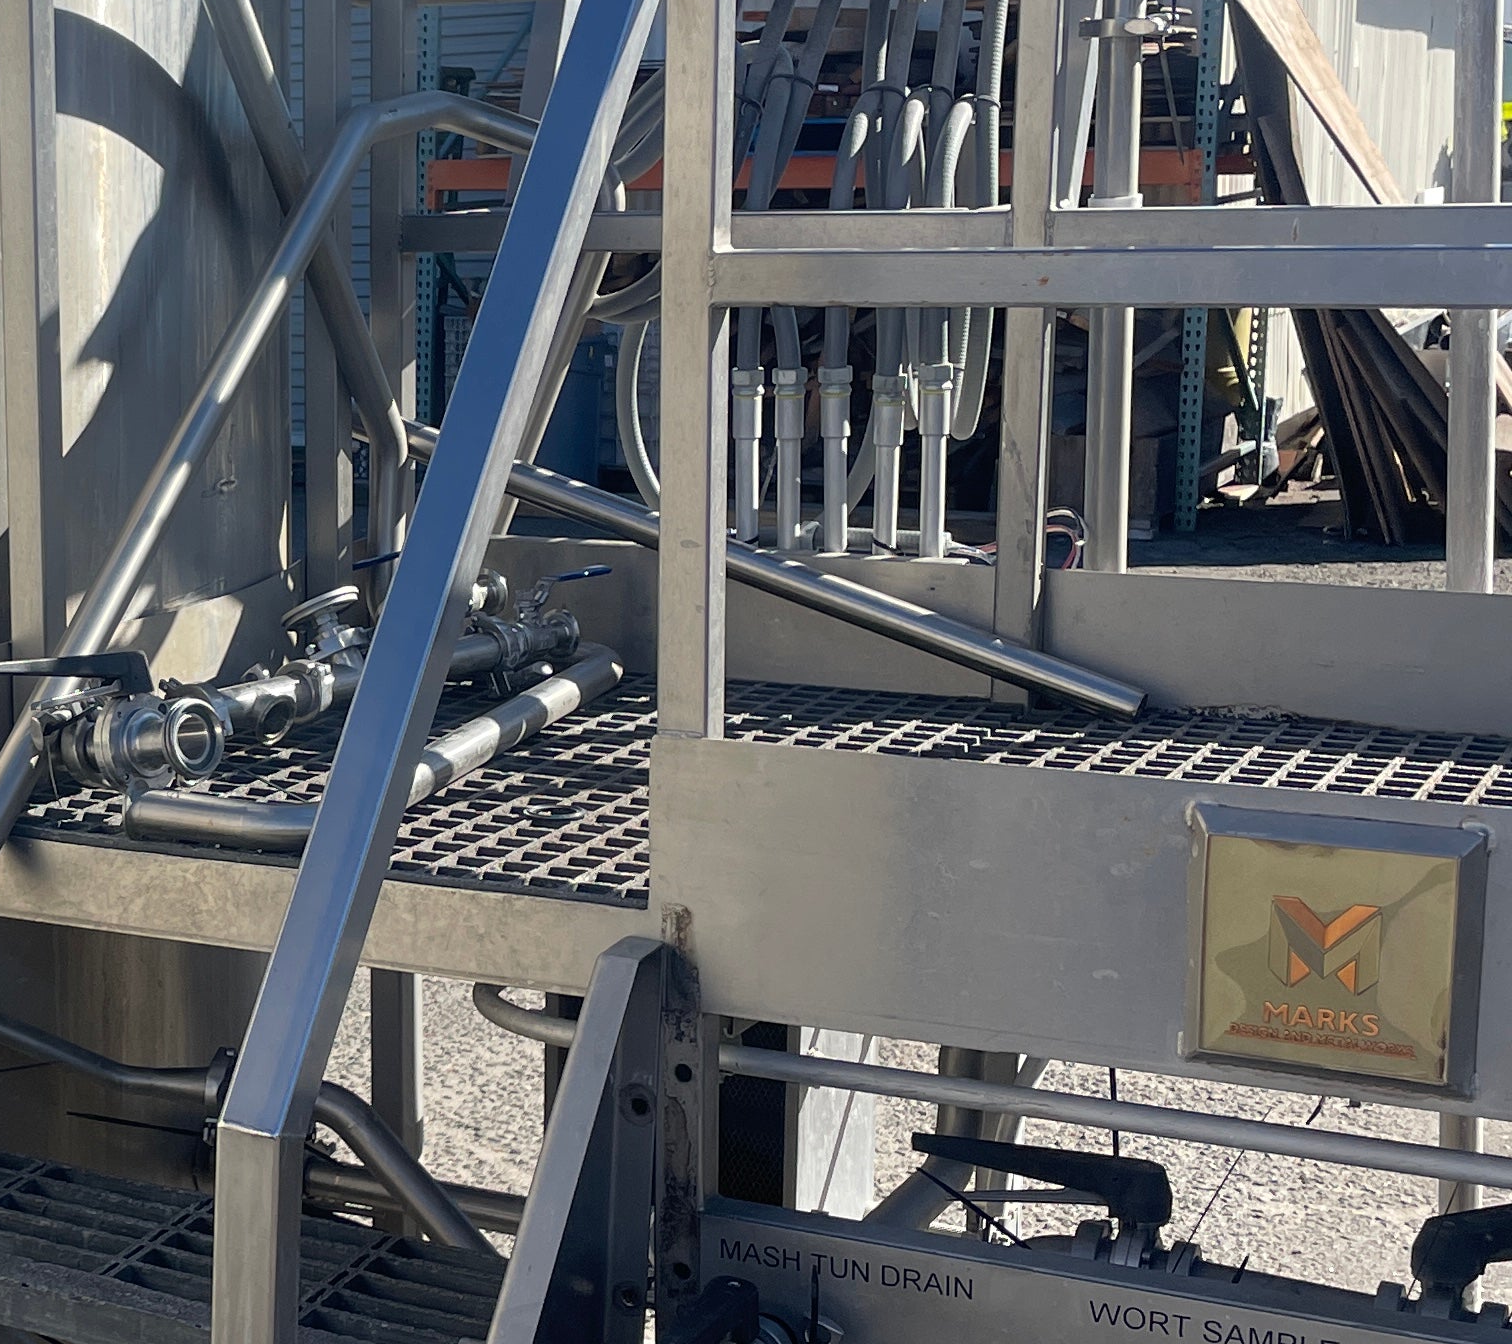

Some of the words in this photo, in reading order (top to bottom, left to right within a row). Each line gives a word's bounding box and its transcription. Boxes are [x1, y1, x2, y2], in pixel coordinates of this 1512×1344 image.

[1262, 1001, 1380, 1037] MARKS
[719, 1238, 801, 1272] MASH
[811, 1253, 870, 1283] TUN
[881, 1264, 973, 1300] DRAIN
[1089, 1300, 1191, 1338] WORT
